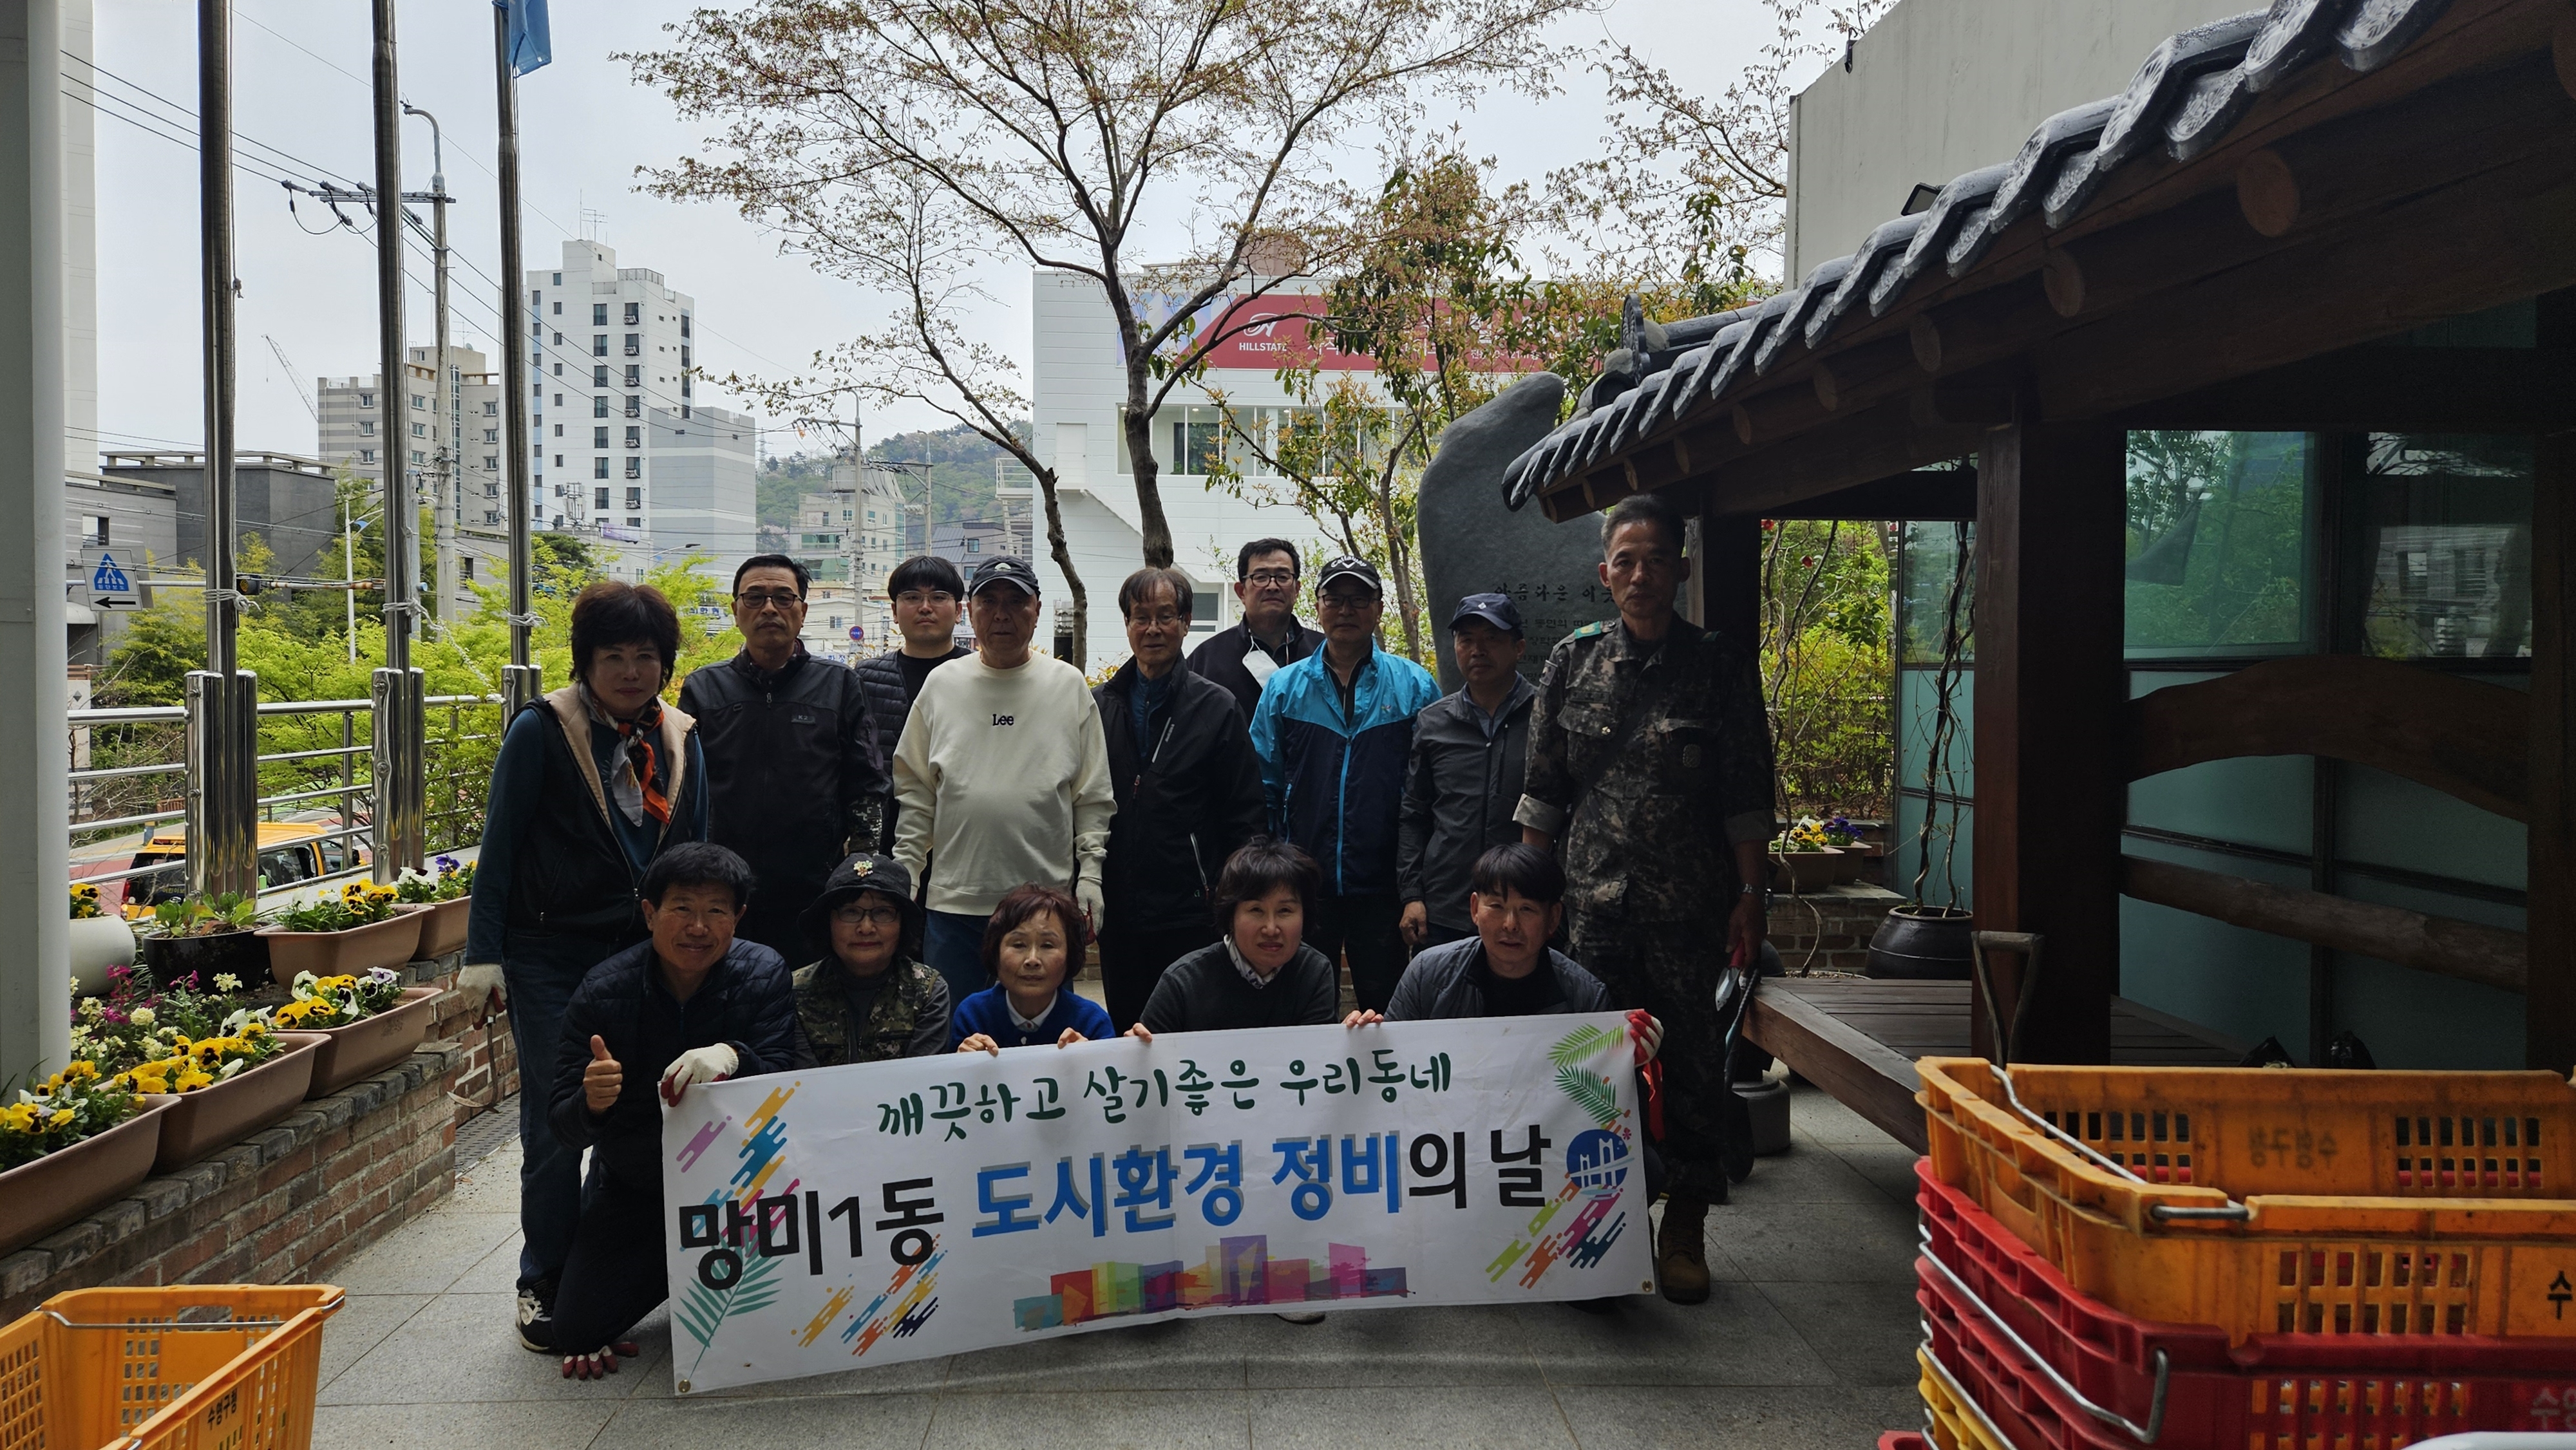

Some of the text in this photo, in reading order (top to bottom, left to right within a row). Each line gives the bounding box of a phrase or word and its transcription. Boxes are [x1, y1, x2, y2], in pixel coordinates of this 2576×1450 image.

[1238, 342, 1287, 352] HILLSTATE
[1331, 555, 1367, 568] Callaway
[992, 713, 1014, 726] Lee
[876, 1048, 1452, 1143] 깨끗하고 살기좋은 우리동네
[678, 1124, 1551, 1290] 망미1동 도시환경 정비의 날
